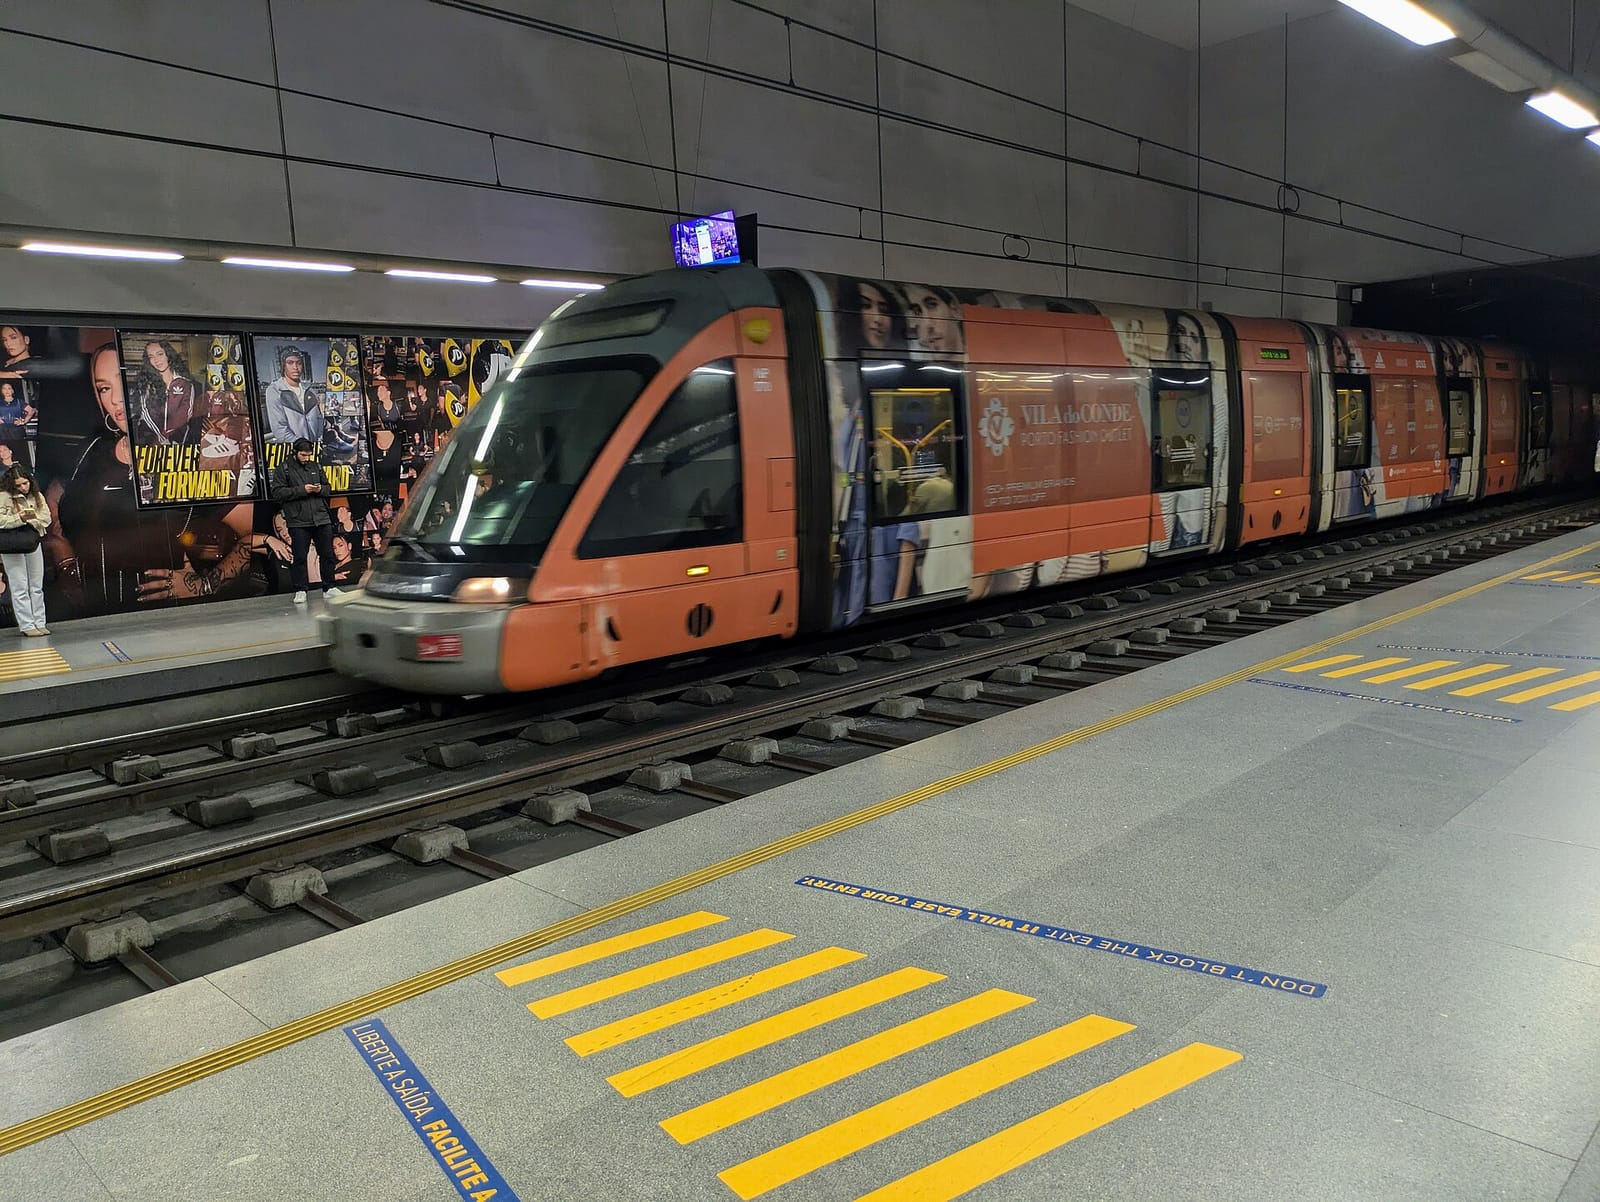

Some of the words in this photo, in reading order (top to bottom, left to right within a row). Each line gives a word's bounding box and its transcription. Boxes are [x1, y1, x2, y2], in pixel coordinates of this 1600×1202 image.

[451, 348, 462, 363] JD
[454, 402, 464, 416] JD
[1020, 404, 1062, 425] VILA
[1080, 402, 1133, 424] CONDE
[136, 443, 200, 474] FOREVER
[158, 469, 232, 499] FORWARD
[801, 877, 861, 895] ENTRY.
[861, 891, 908, 906] YOUR
[910, 900, 963, 917] EASE
[967, 911, 1014, 929] WILL
[1016, 923, 1040, 934] IT
[1045, 928, 1093, 945] EXIT.
[1096, 939, 1140, 957] THE
[1146, 950, 1226, 975] BLOCK
[352, 1023, 401, 1071] LIBERTE
[383, 1069, 406, 1081] A
[391, 1078, 434, 1122] SAÍDA.
[422, 1119, 489, 1190] FACILITE
[470, 1188, 498, 1202] A
